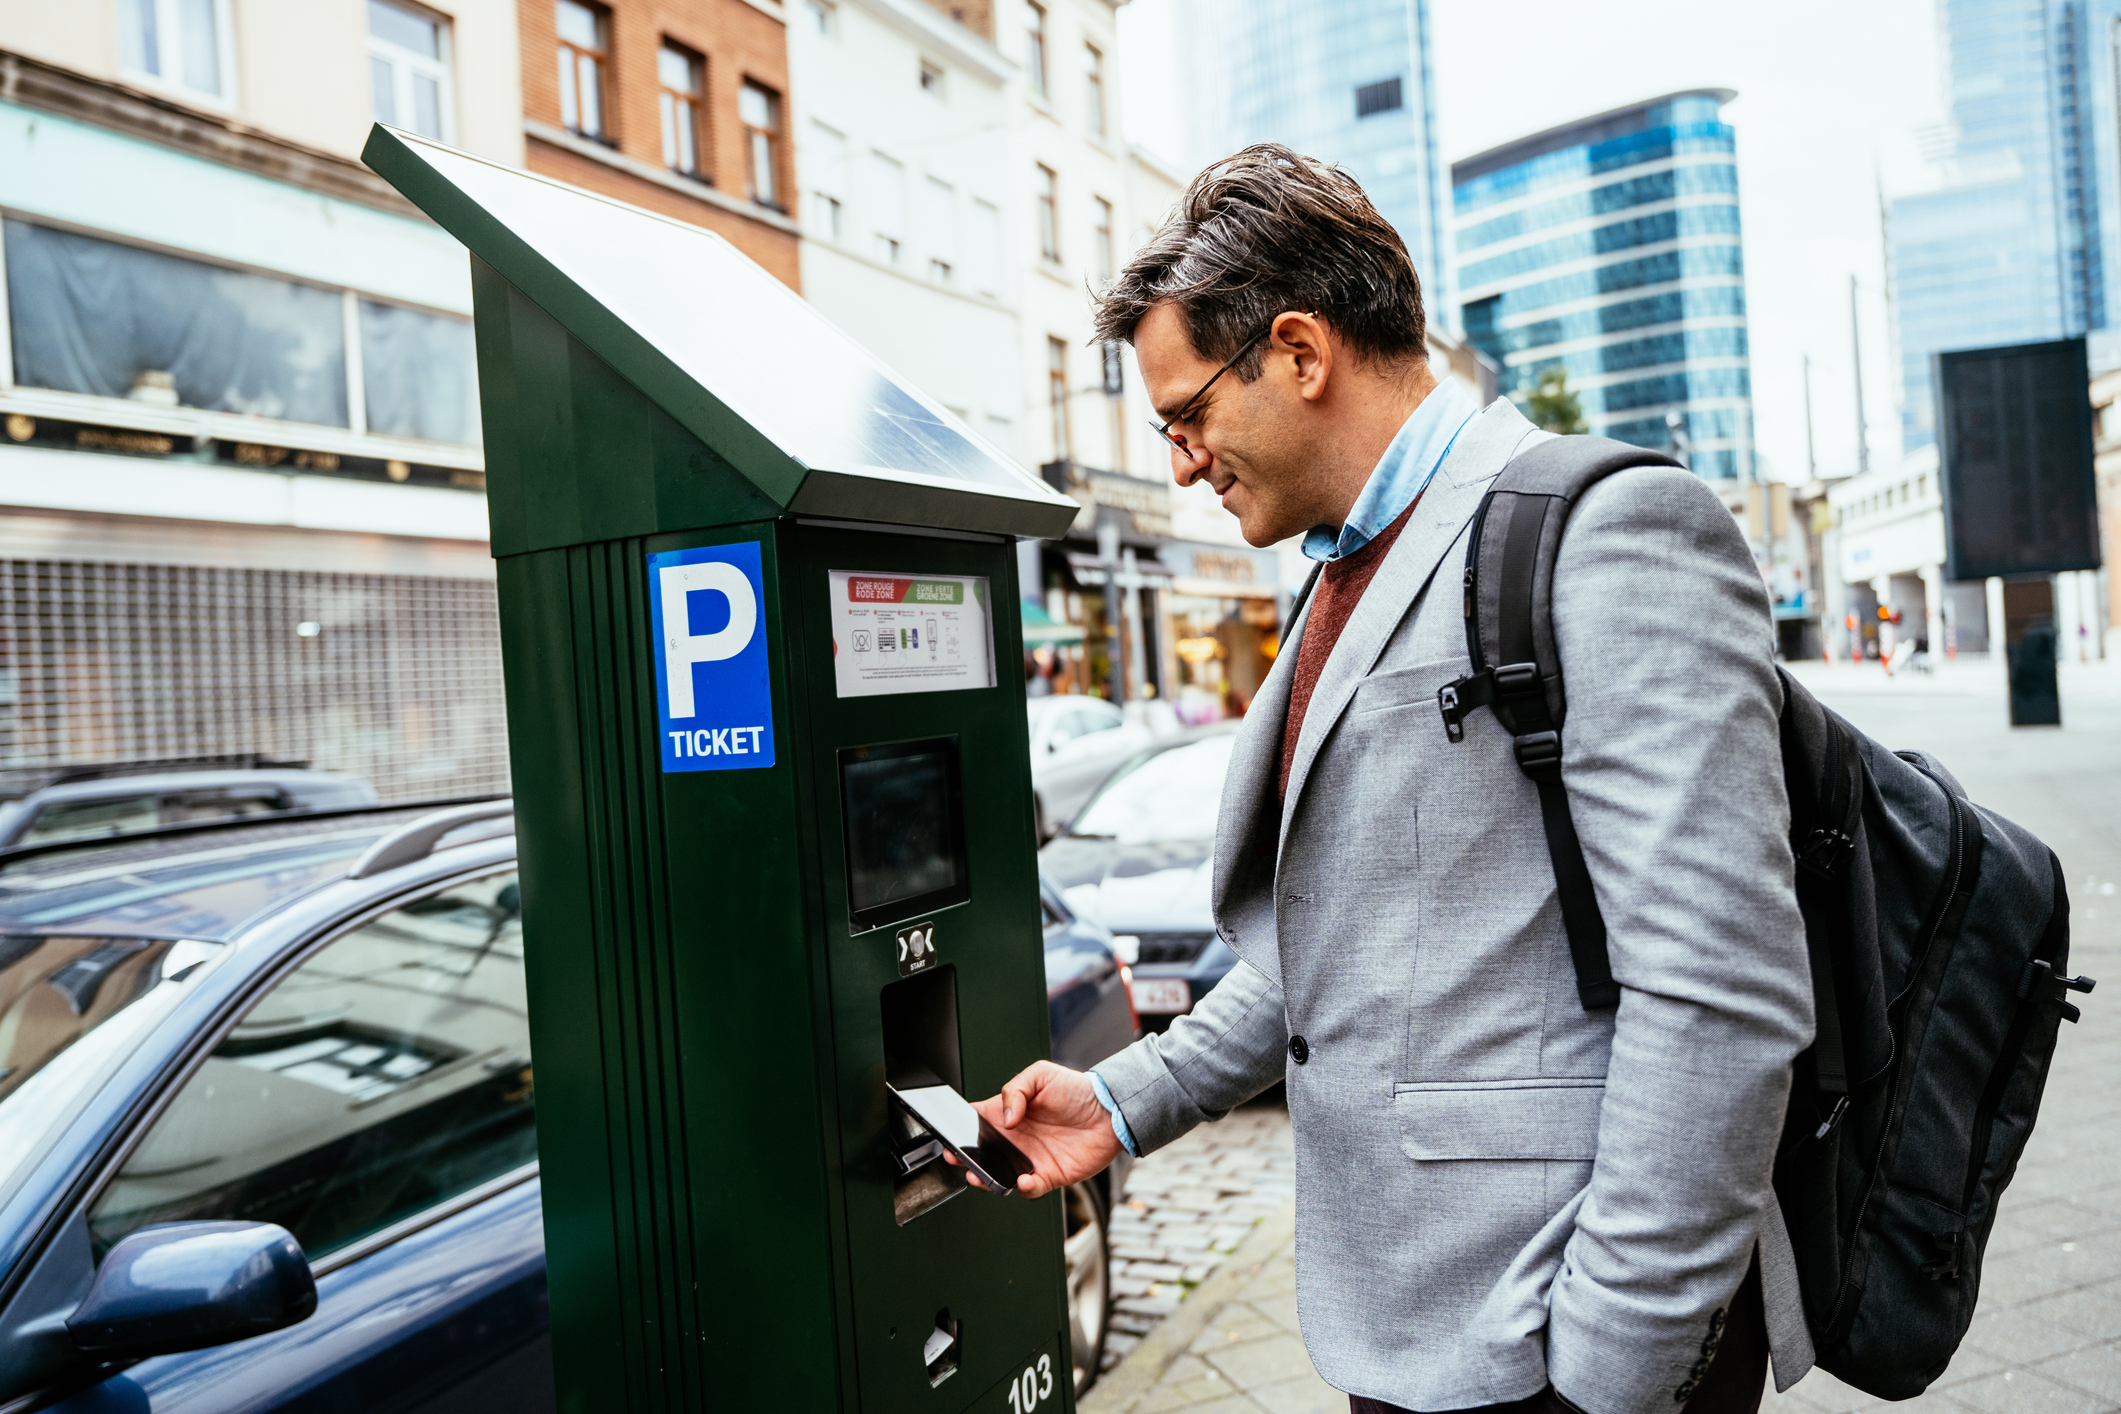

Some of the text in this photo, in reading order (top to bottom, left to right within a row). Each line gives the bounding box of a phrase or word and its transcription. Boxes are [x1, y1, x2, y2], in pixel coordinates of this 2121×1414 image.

[856, 581, 895, 591] ZONE ROUGE
[916, 584, 954, 594] ZONE VERTE
[856, 590, 895, 600] RODE ZONE
[916, 592, 954, 601] GROENE ZONE
[659, 561, 757, 719] P
[668, 726, 764, 758] TICKET
[910, 959, 926, 971] START
[1008, 1353, 1053, 1414] 103
